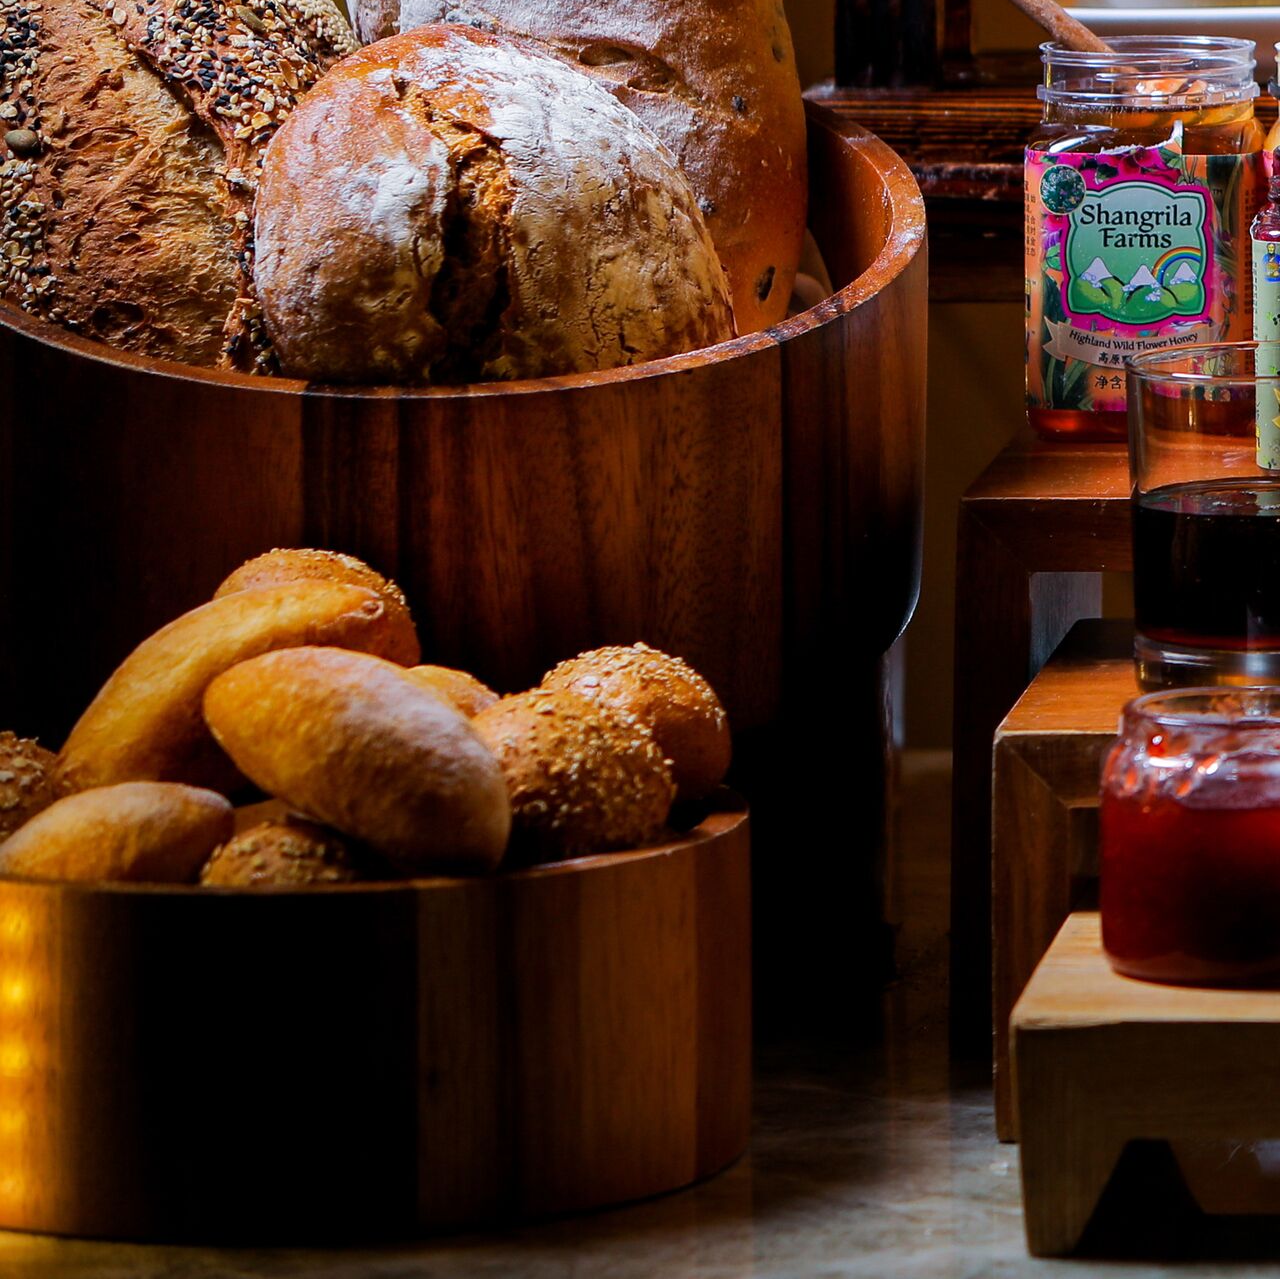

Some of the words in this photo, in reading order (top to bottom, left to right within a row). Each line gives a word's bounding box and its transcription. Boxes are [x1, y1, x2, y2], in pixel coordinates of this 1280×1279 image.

[1080, 204, 1193, 233] Shangrila
[1098, 227, 1172, 249] Farms
[1069, 330, 1111, 349] Highland
[1113, 341, 1134, 351] Wild
[1136, 340, 1167, 351] Flower
[1168, 332, 1198, 348] Honey
